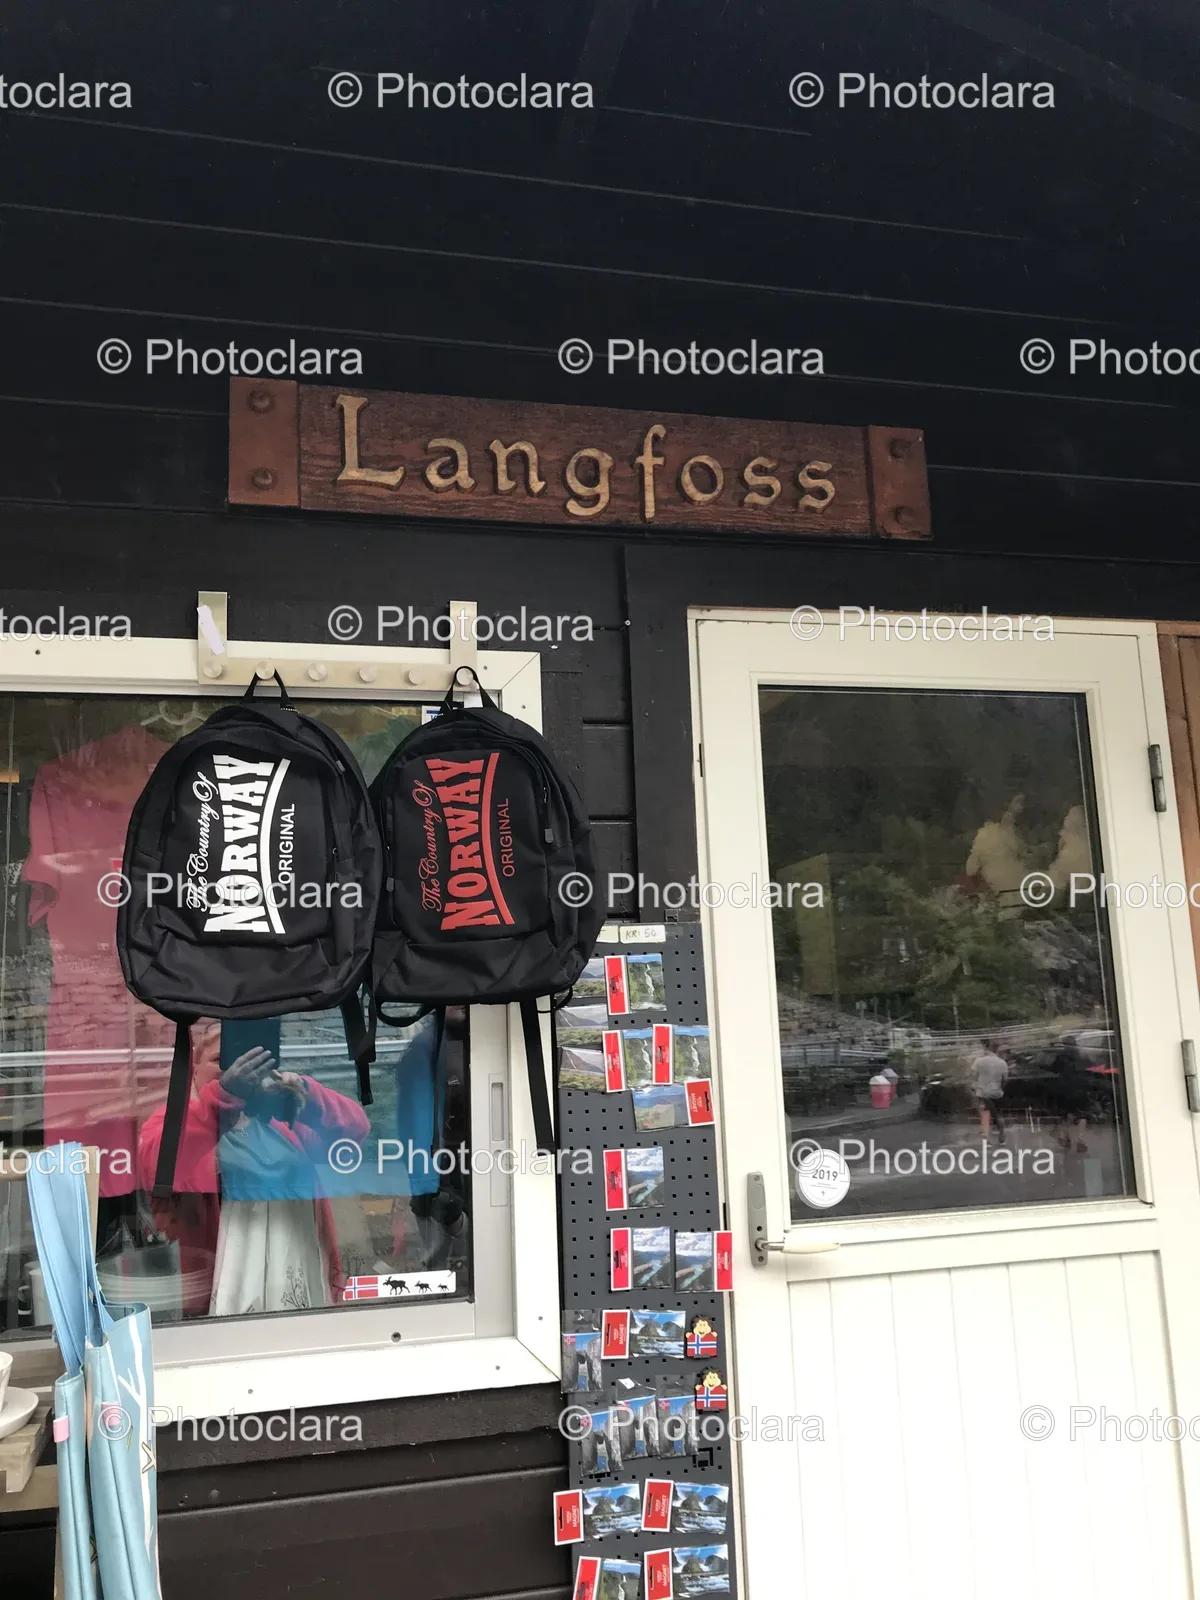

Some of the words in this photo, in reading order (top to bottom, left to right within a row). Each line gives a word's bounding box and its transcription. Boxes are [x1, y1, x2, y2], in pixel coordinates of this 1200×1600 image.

[335, 393, 837, 520] Langfoss
[192, 771, 220, 802] Of
[411, 779, 438, 807] Of
[187, 802, 220, 877] Country
[203, 754, 275, 933] NORWAY
[278, 803, 296, 885] ORIGINAL
[418, 806, 443, 880] Country
[425, 758, 501, 931] NORWAY
[497, 798, 516, 878] ORIGINAL
[421, 877, 442, 913] The
[643, 928, 657, 939] 50
[811, 1169, 839, 1182] 2019
